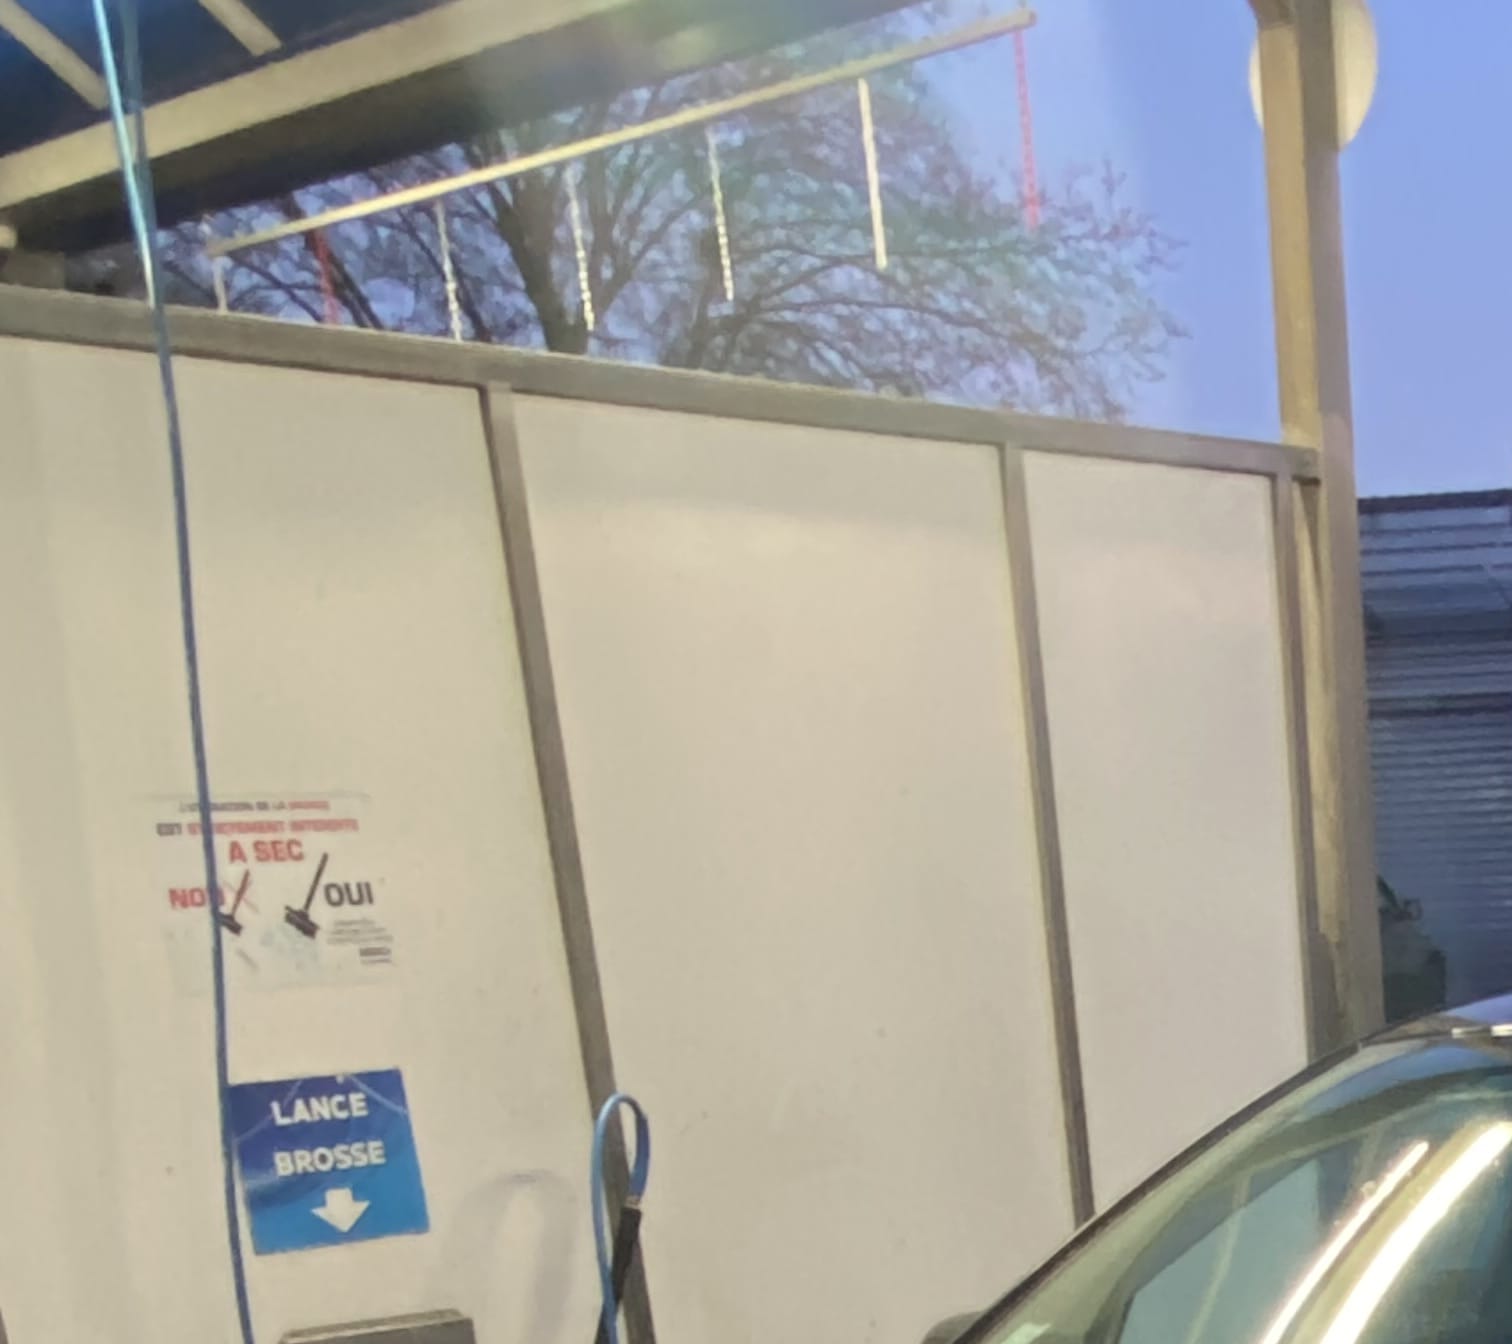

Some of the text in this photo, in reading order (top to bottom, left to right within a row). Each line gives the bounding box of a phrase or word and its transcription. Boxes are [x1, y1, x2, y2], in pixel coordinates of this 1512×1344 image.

[229, 839, 304, 863] A SEC
[324, 882, 373, 908] OUI
[270, 1093, 369, 1127] LANCE
[275, 1141, 387, 1177] BROSSE
